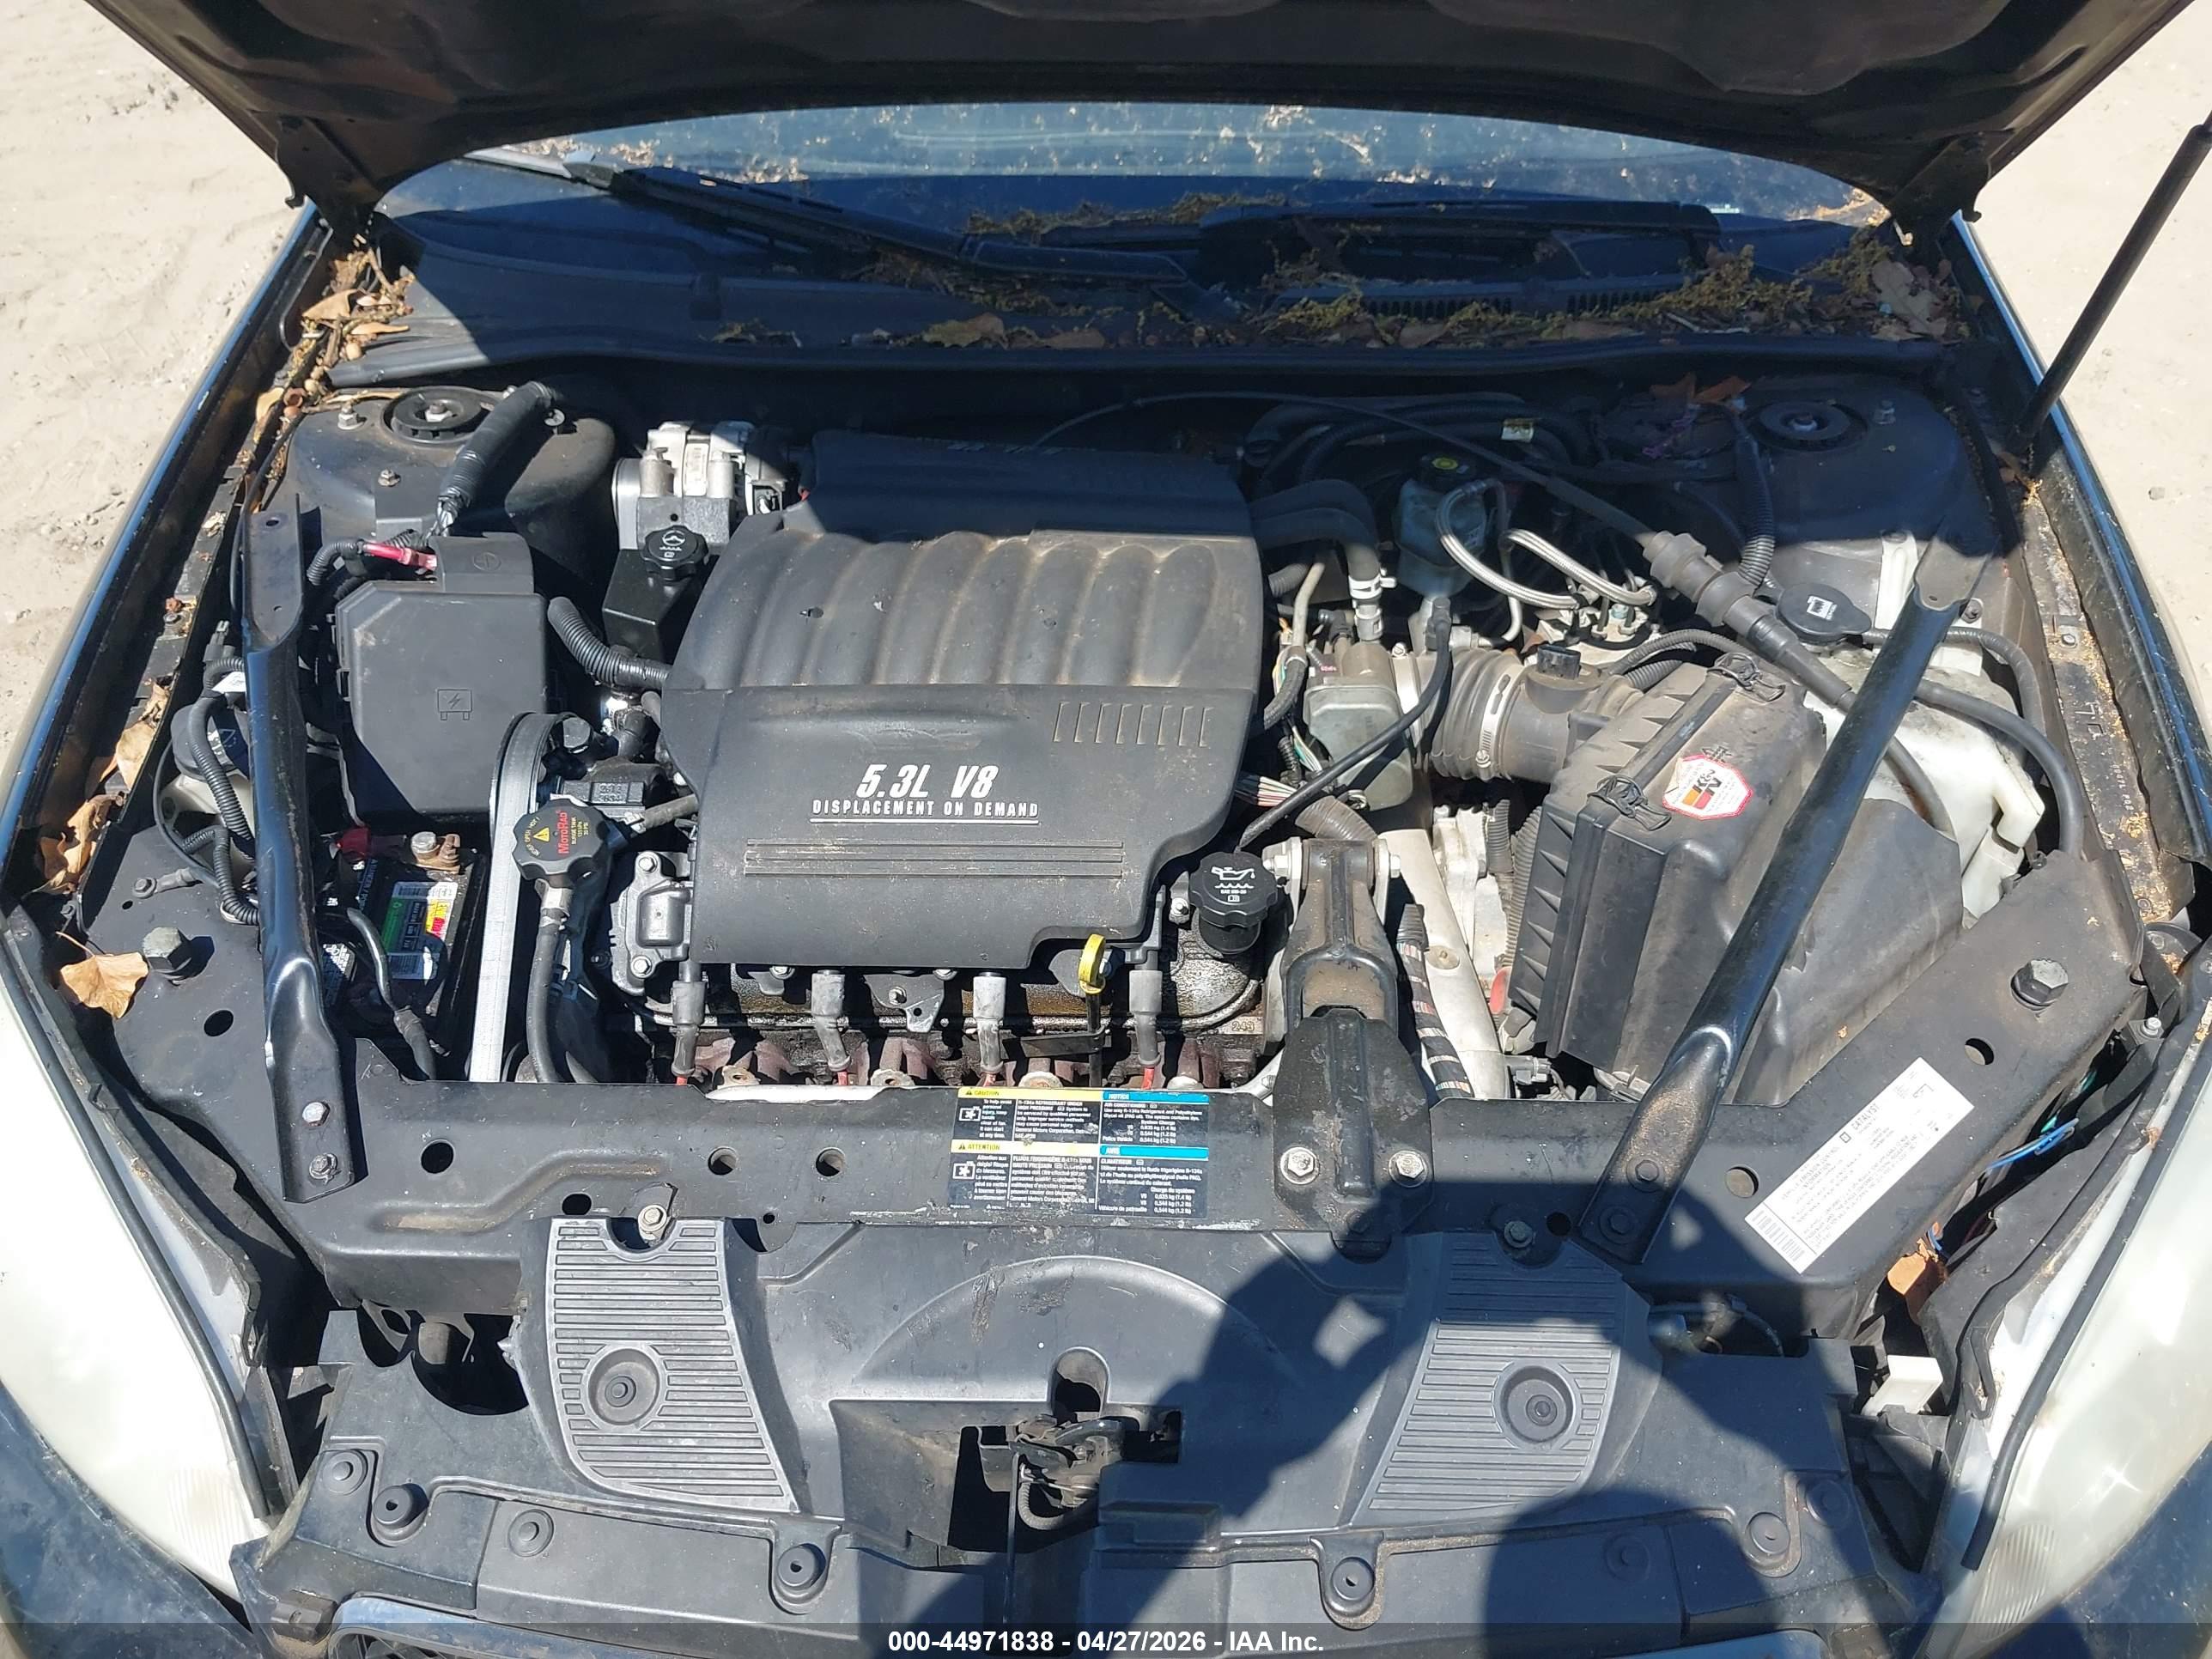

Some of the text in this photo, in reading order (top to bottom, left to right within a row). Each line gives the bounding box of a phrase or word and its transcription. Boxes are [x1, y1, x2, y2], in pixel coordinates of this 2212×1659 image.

[855, 763, 1000, 799] 5.3L V8
[812, 799, 1039, 817] DISPLACEMENT ON DEMAND
[1231, 1021, 1255, 1032] 243
